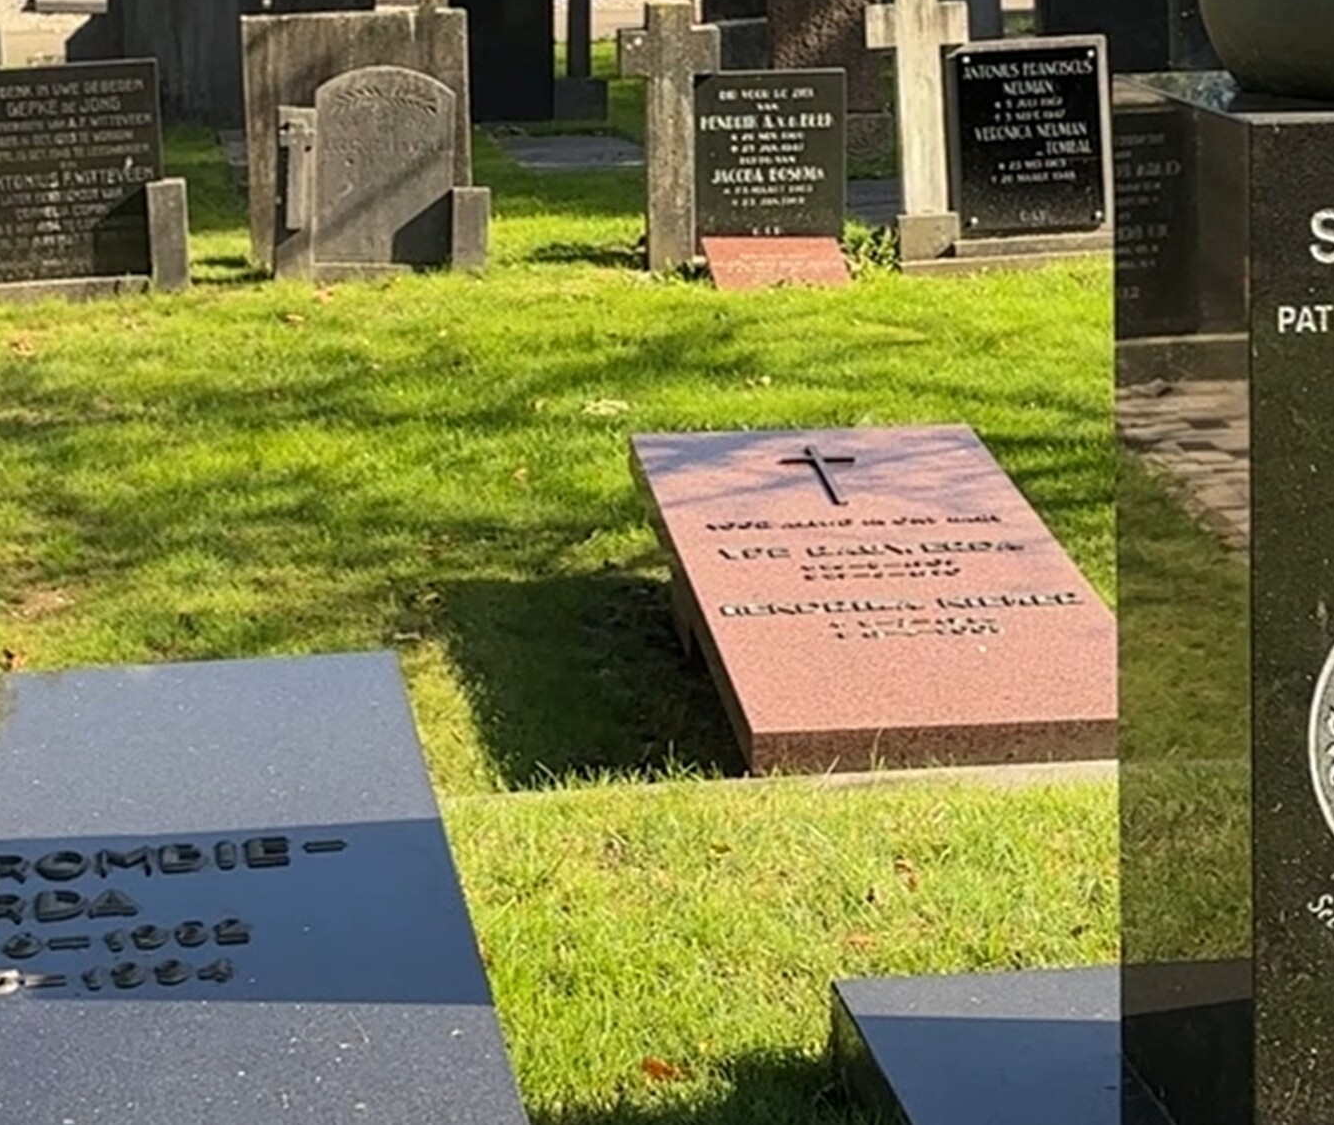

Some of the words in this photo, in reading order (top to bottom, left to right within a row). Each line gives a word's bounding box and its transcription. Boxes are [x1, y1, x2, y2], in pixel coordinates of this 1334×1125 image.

[962, 62, 1019, 80] ANTONIUS
[1022, 59, 1093, 78] FRANCISCUS
[1003, 79, 1055, 96] NEUMAN
[6, 99, 58, 118] GEPKE
[79, 96, 121, 114] JONG
[974, 125, 1033, 142] VERONICA
[1036, 121, 1088, 138] NEUMAN
